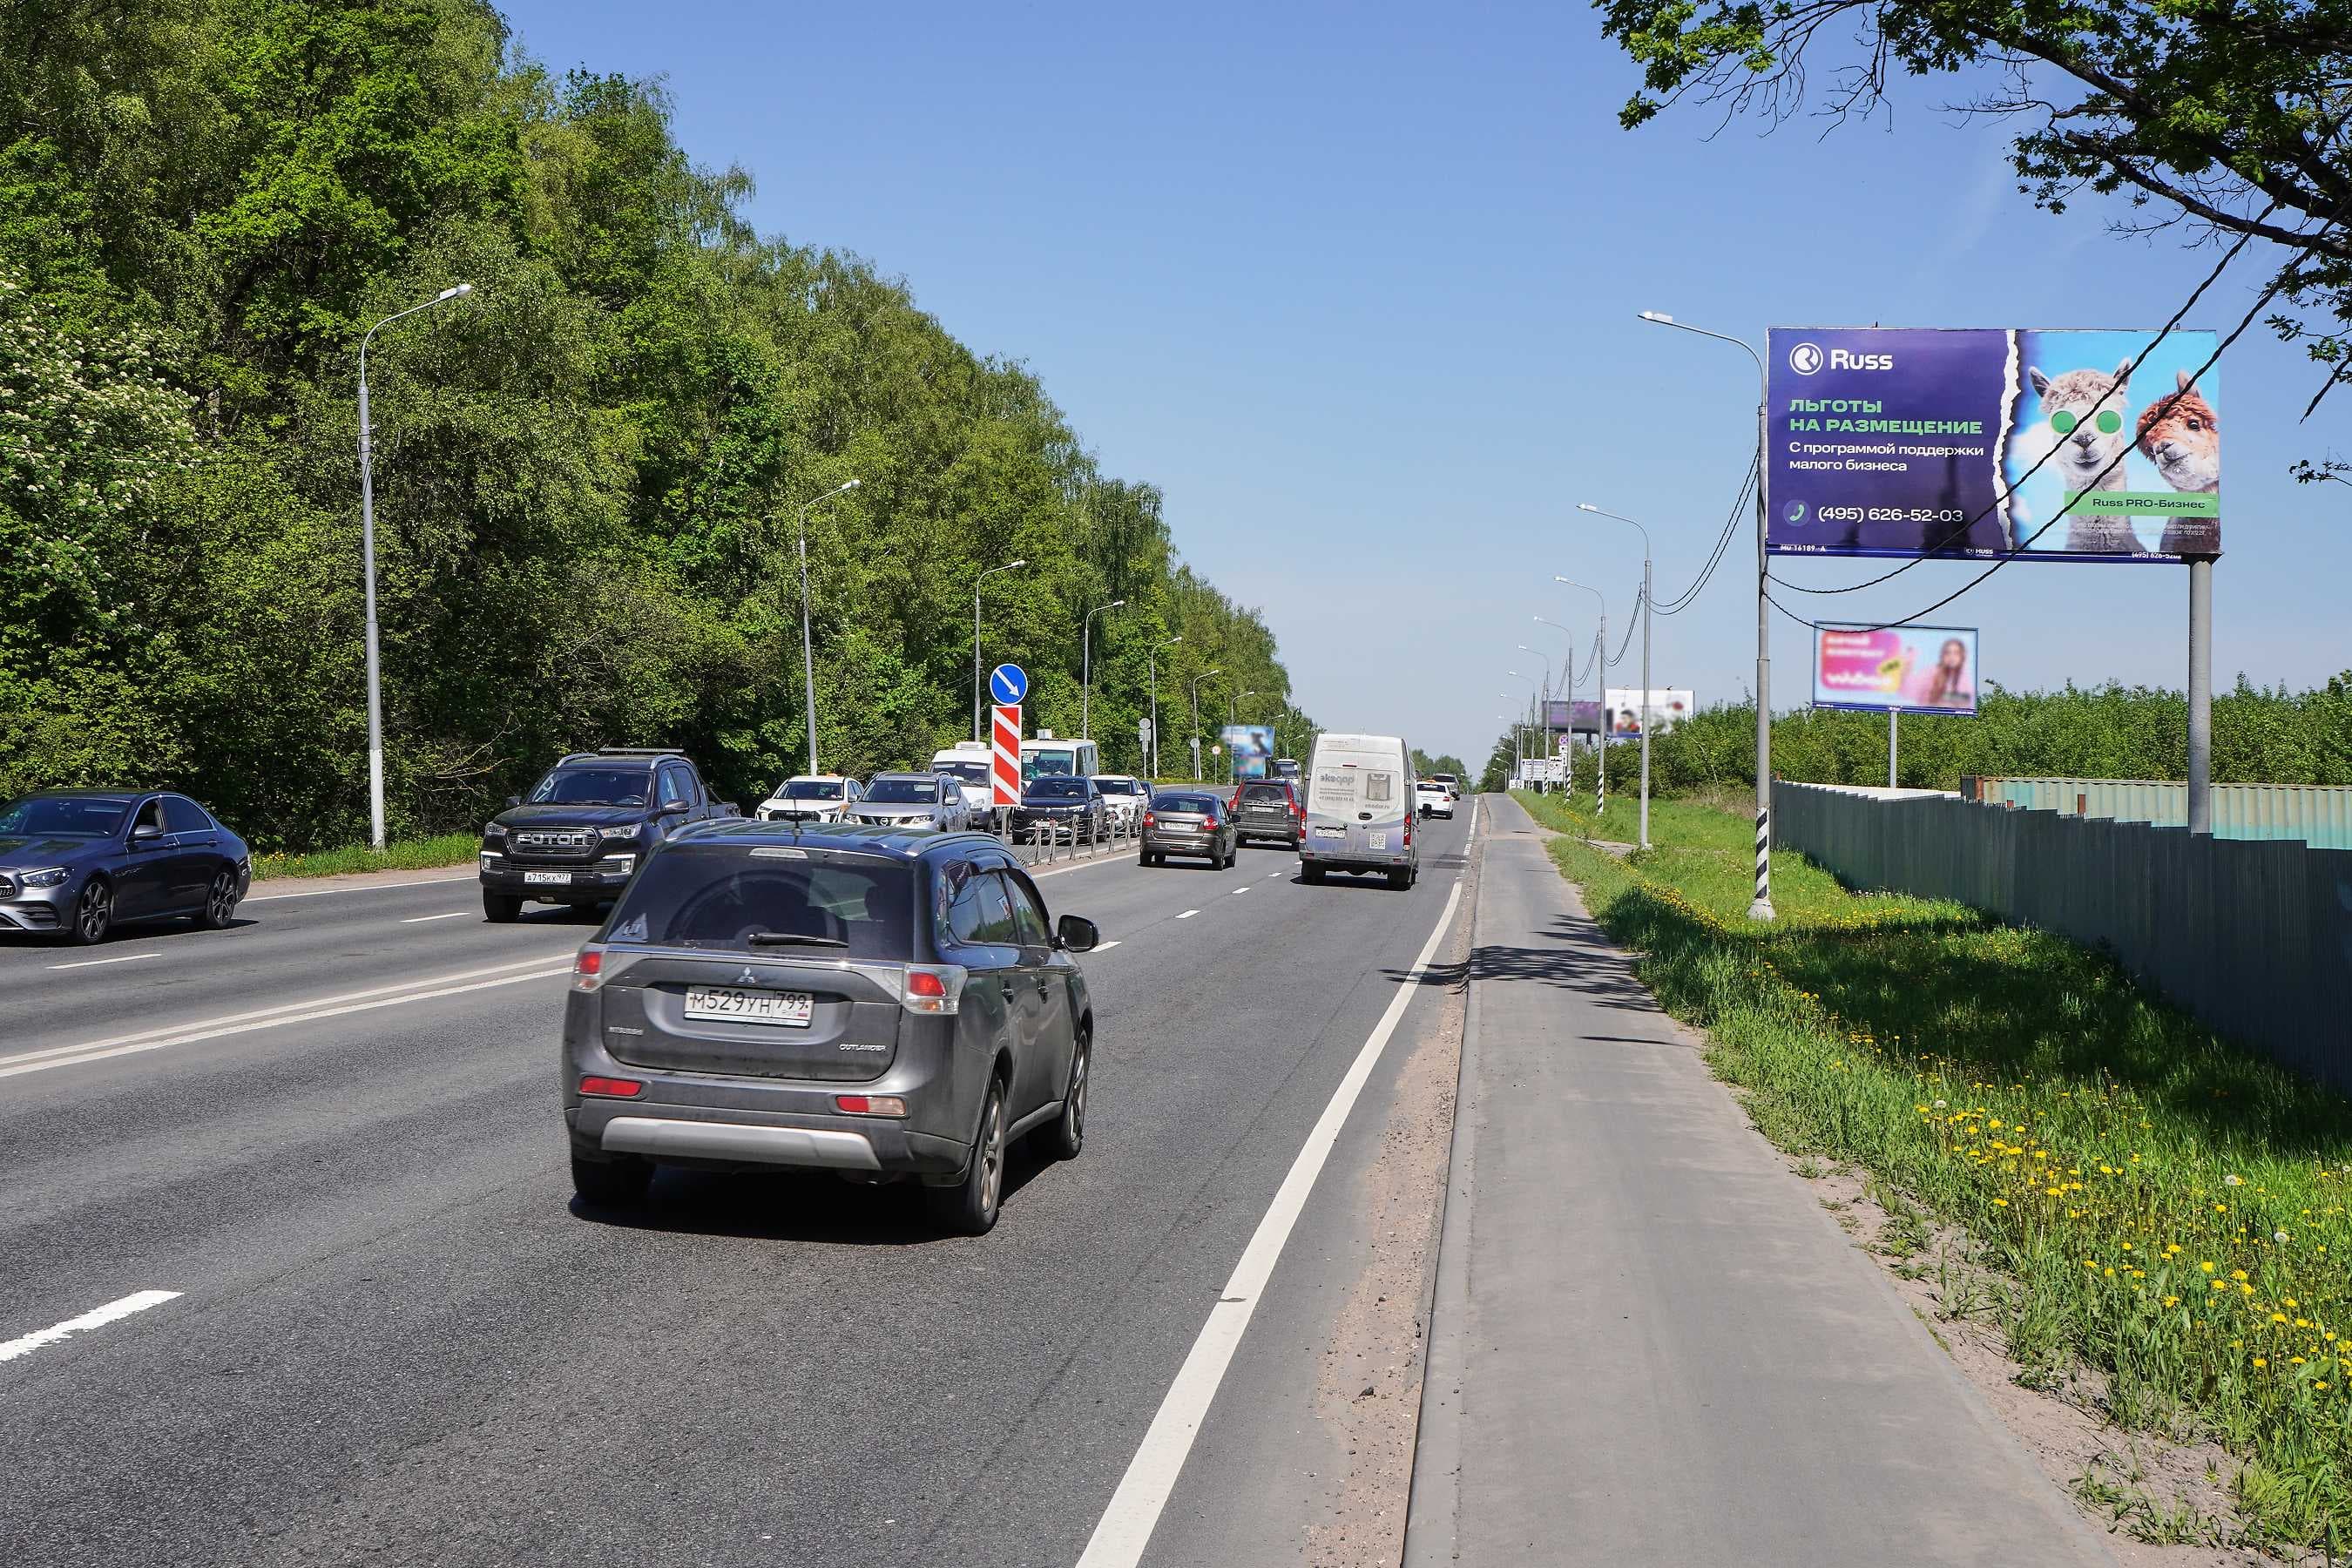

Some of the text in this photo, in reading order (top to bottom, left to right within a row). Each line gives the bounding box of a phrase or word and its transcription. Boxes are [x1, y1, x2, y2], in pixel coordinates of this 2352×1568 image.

[1830, 348, 1894, 371] Russ
[1788, 398, 1882, 414] ЛЬГОТЫ
[1789, 418, 1983, 436] НА РАЗМЕЩЕНИЕ
[1789, 442, 1984, 458] С программой поддержки
[1789, 457, 1908, 471] малого бизнеса
[2092, 497, 2207, 510] Russ PRO-Бизнес
[1818, 506, 1963, 524] (495) 626-52-03
[517, 833, 589, 846] FOTON
[691, 989, 770, 1015] М529УН
